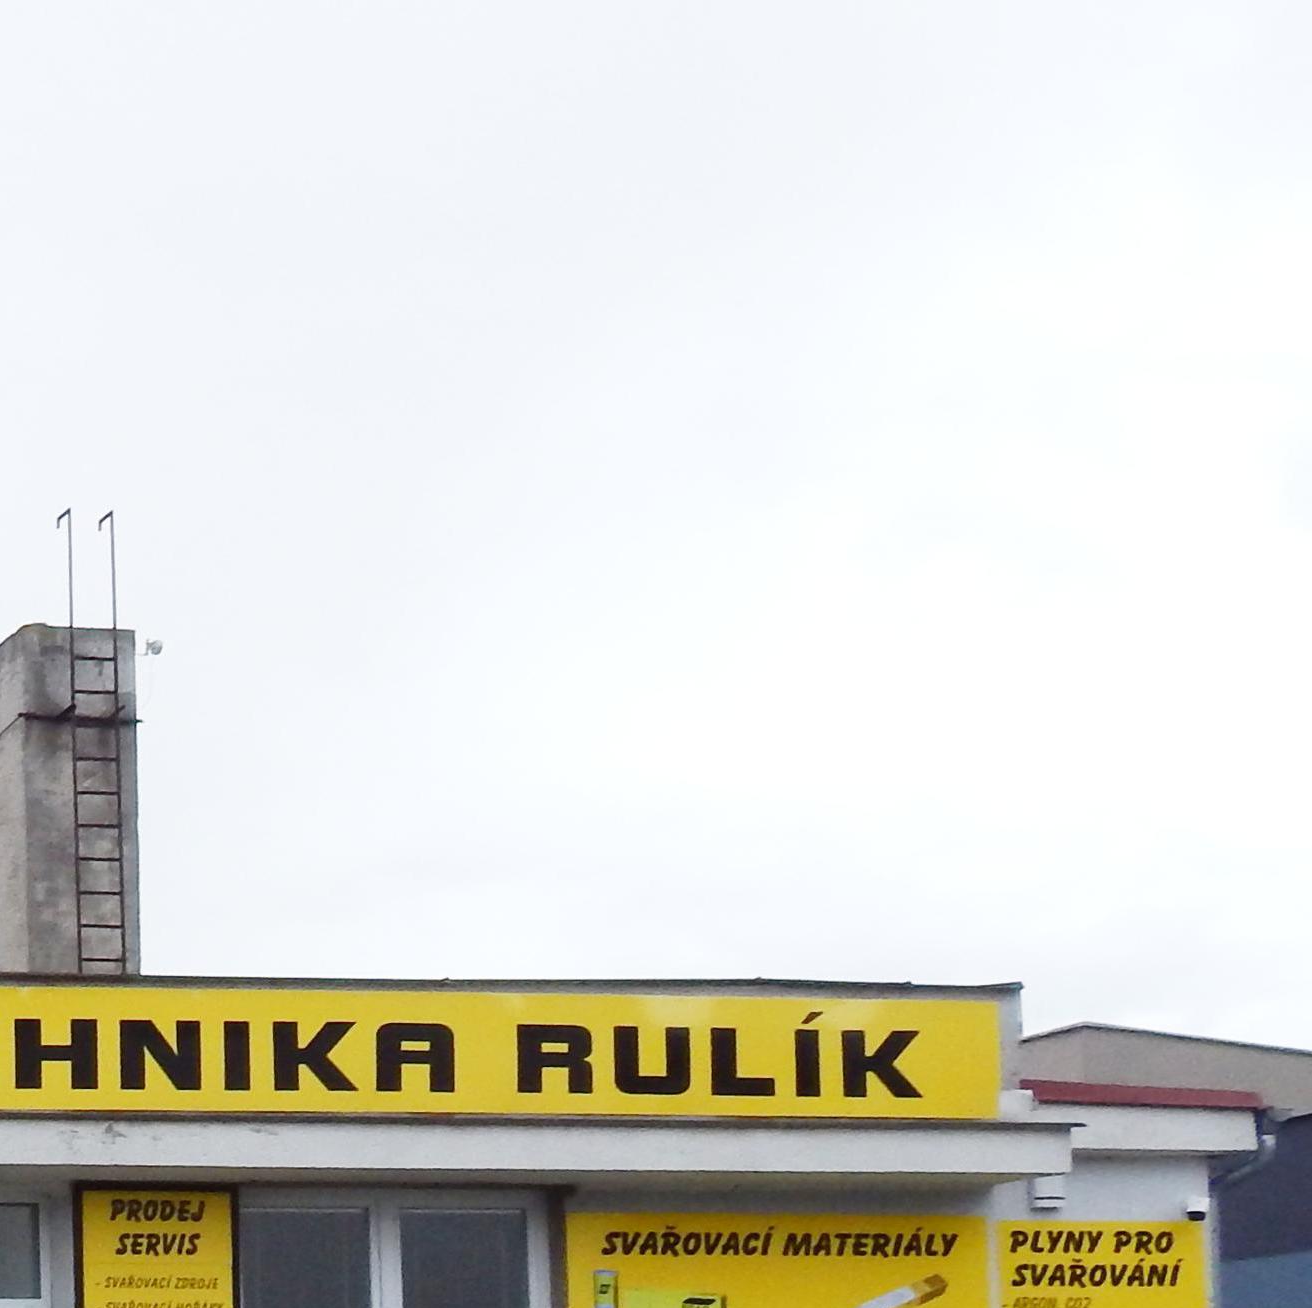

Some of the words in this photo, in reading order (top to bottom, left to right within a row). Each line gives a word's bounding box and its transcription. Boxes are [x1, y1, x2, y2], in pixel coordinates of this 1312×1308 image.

[516, 1011, 924, 1099] RULÍK
[109, 1198, 206, 1223] PRODEJ
[115, 1232, 201, 1257] SERVIS
[600, 1225, 776, 1259] SVAŘOVACÍ
[782, 1226, 959, 1259] MATERIÁLY
[1009, 1230, 1103, 1254] PLYNY
[1113, 1230, 1174, 1255] PRO
[104, 1274, 171, 1290] SVAŘOVACÍ
[174, 1277, 219, 1290] ZDROJE
[1011, 1258, 1183, 1288] SVAŘOVÁNÍ
